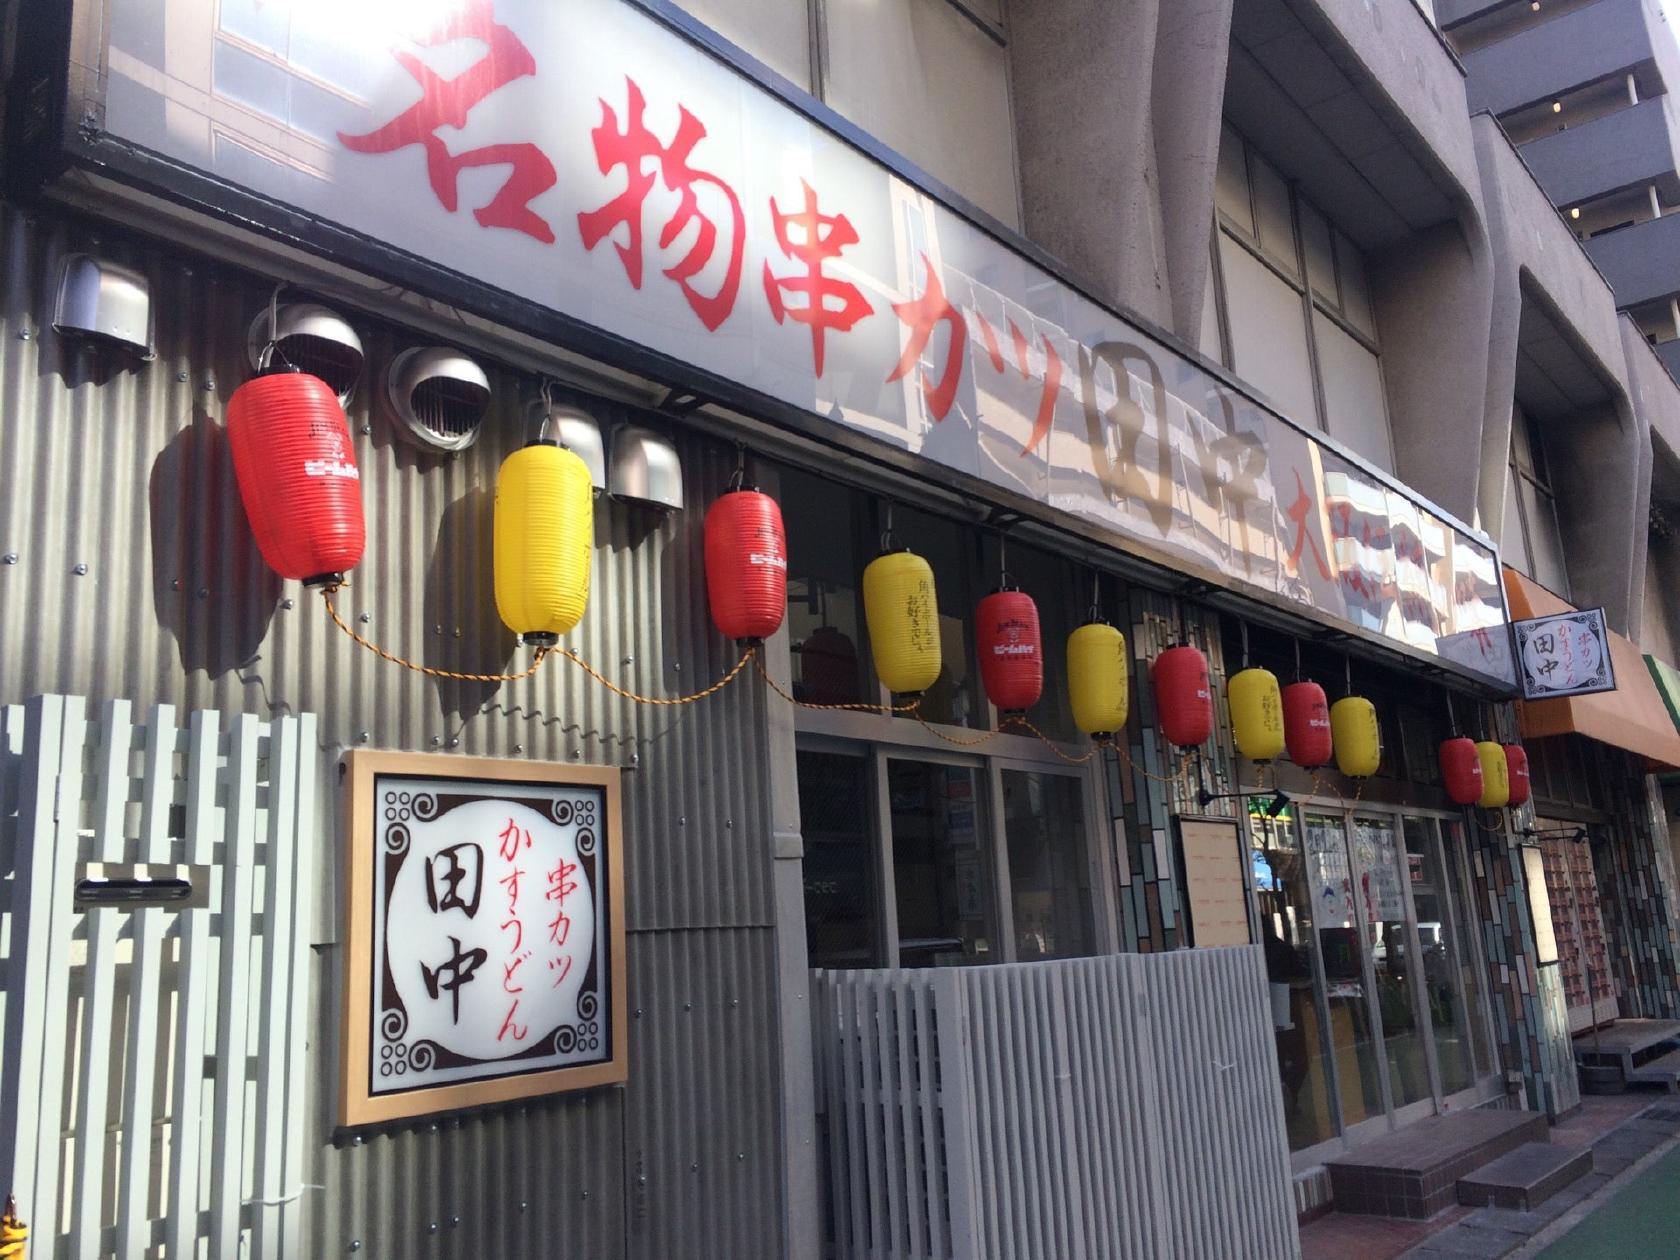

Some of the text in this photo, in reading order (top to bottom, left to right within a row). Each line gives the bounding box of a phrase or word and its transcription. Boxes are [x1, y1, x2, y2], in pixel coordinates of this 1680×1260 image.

[1533, 633, 1559, 681] 田中
[419, 841, 488, 1026] 田中
[496, 817, 532, 1042] かすうどん
[544, 857, 578, 989] 串カツ
